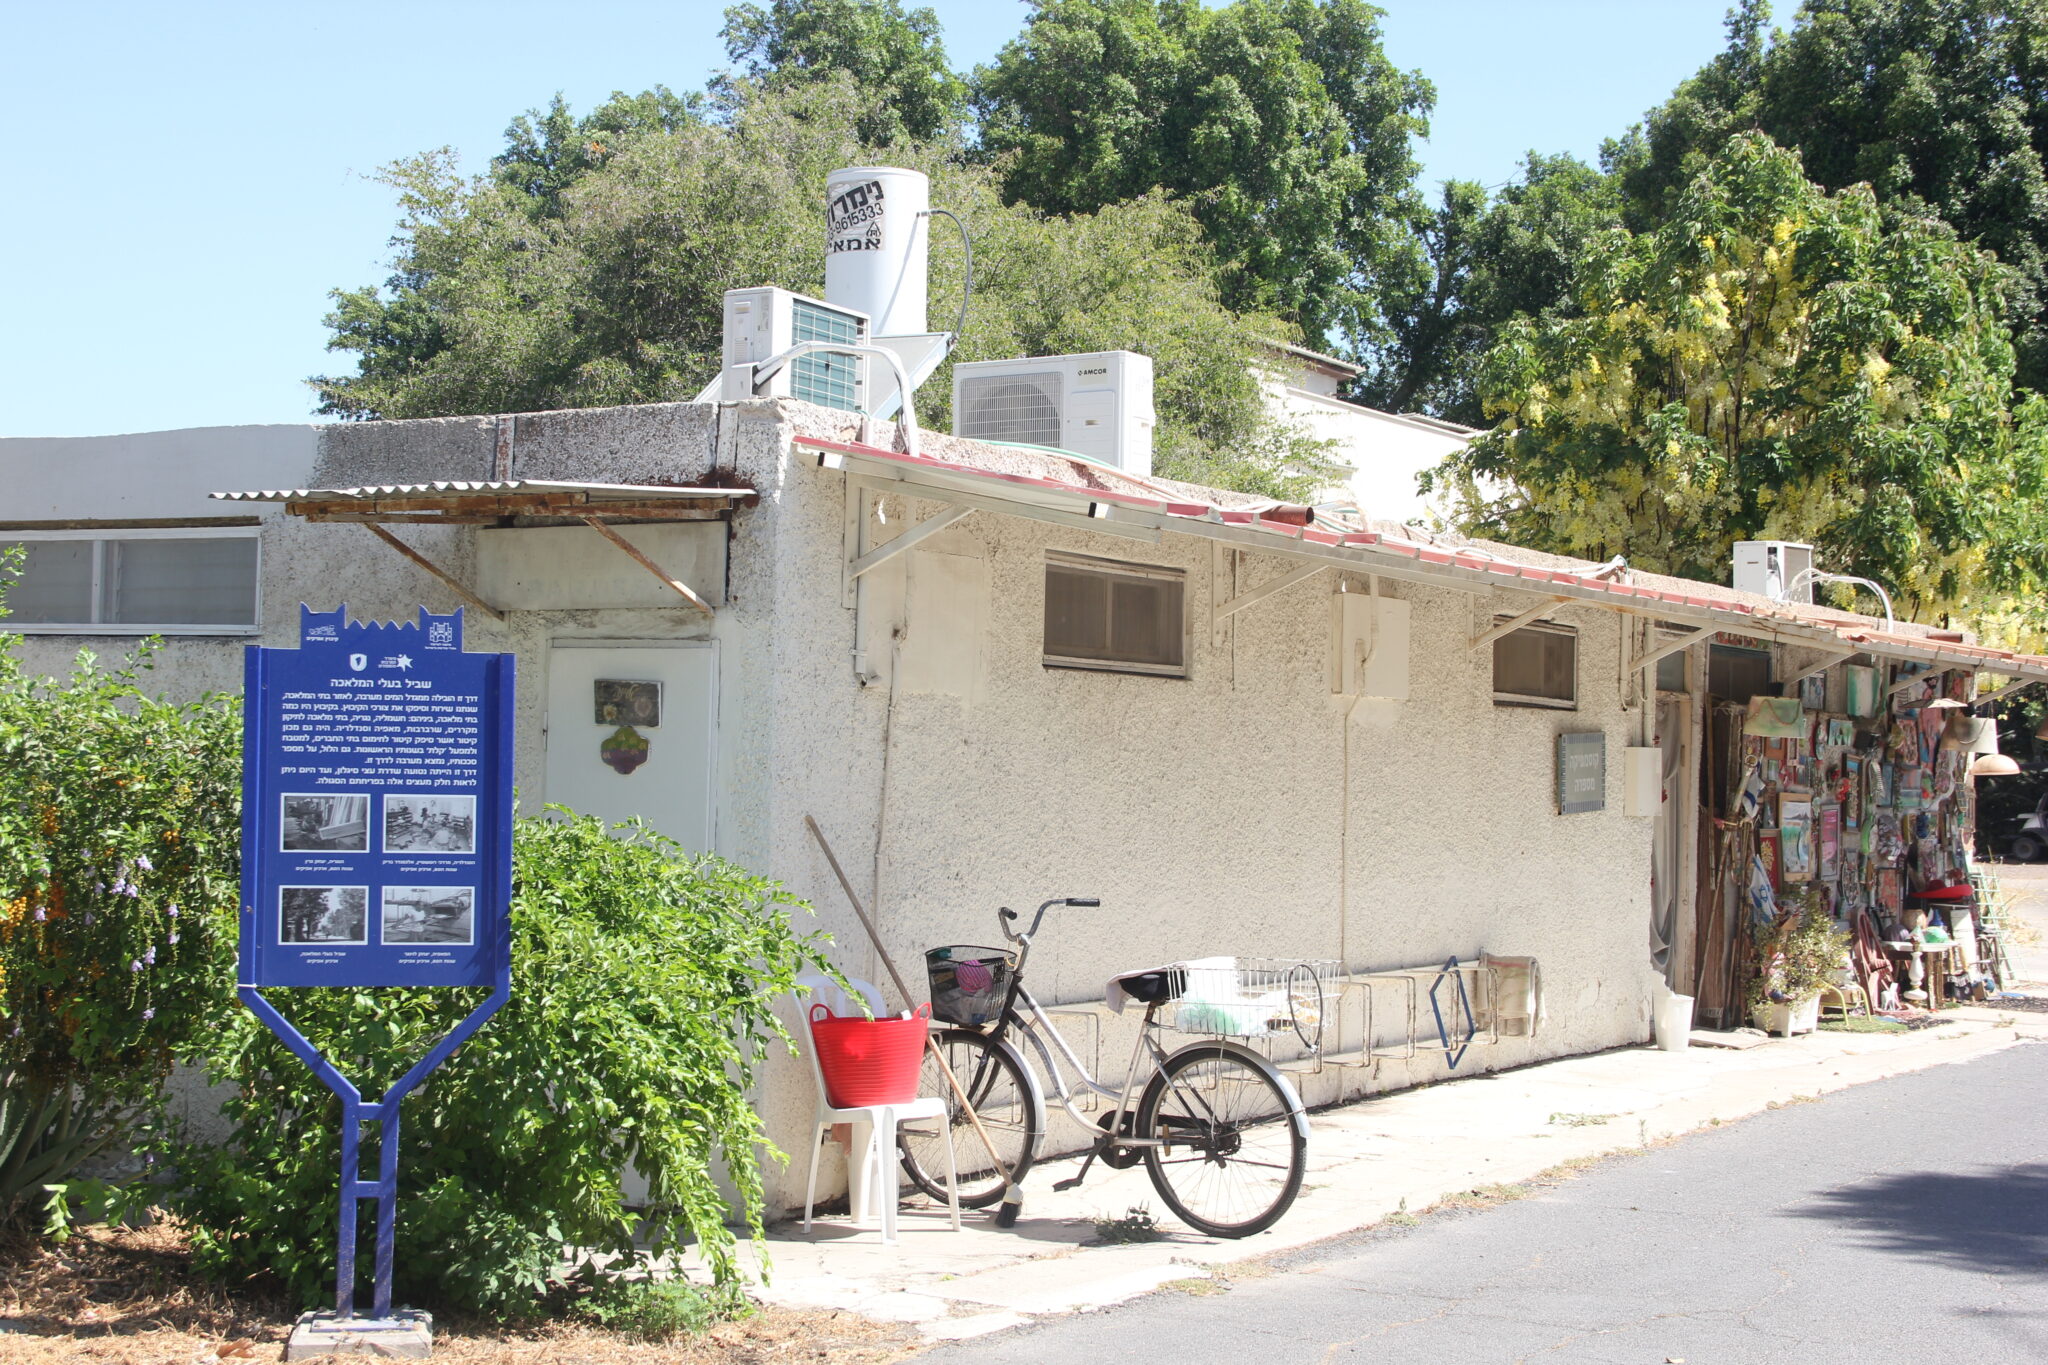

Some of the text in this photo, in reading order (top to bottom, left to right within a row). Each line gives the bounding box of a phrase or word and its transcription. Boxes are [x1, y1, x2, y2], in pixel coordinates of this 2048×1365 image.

[331, 677, 432, 689] שביל בעלי המלאכה
[282, 691, 316, 700] המלאכה,
[317, 692, 331, 700] בתי
[405, 693, 430, 701] ממגדל
[431, 693, 455, 702] הובילה
[465, 695, 478, 704] דרך
[282, 702, 299, 710] כמה
[313, 703, 339, 712] בקיבוץ
[341, 704, 369, 712] הקיבוץ.
[405, 705, 429, 713] וסיפקו
[282, 712, 305, 722] לתיקון
[307, 712, 333, 721] מלאכה
[435, 715, 463, 724] מלאכה,
[282, 724, 300, 732] מכון
[333, 723, 372, 732] וסנדלריה.
[373, 725, 401, 733] מאפיה
[403, 726, 443, 734] שרברבות,
[444, 726, 478, 735] מקררים,
[282, 733, 310, 742] למטבח
[312, 735, 344, 743] החברים,
[346, 735, 360, 743] בתי
[362, 735, 389, 743] לחימום
[391, 736, 413, 745] קיטור
[414, 736, 434, 745] סיפק
[456, 737, 478, 746] קיטור
[306, 744, 317, 752] על
[319, 744, 339, 754] הלול,
[448, 746, 477, 755] ולמפעל
[375, 756, 394, 765] לדרך
[281, 766, 296, 775] ניתן
[299, 766, 316, 774] היום
[334, 766, 359, 775] סיגלון,
[463, 769, 477, 777] דרך
[387, 777, 404, 785] אלה
[406, 778, 432, 786] מעצים
[434, 777, 451, 787] חלק
[453, 778, 477, 786] לראות
[1574, 778, 1595, 792] מספרה
